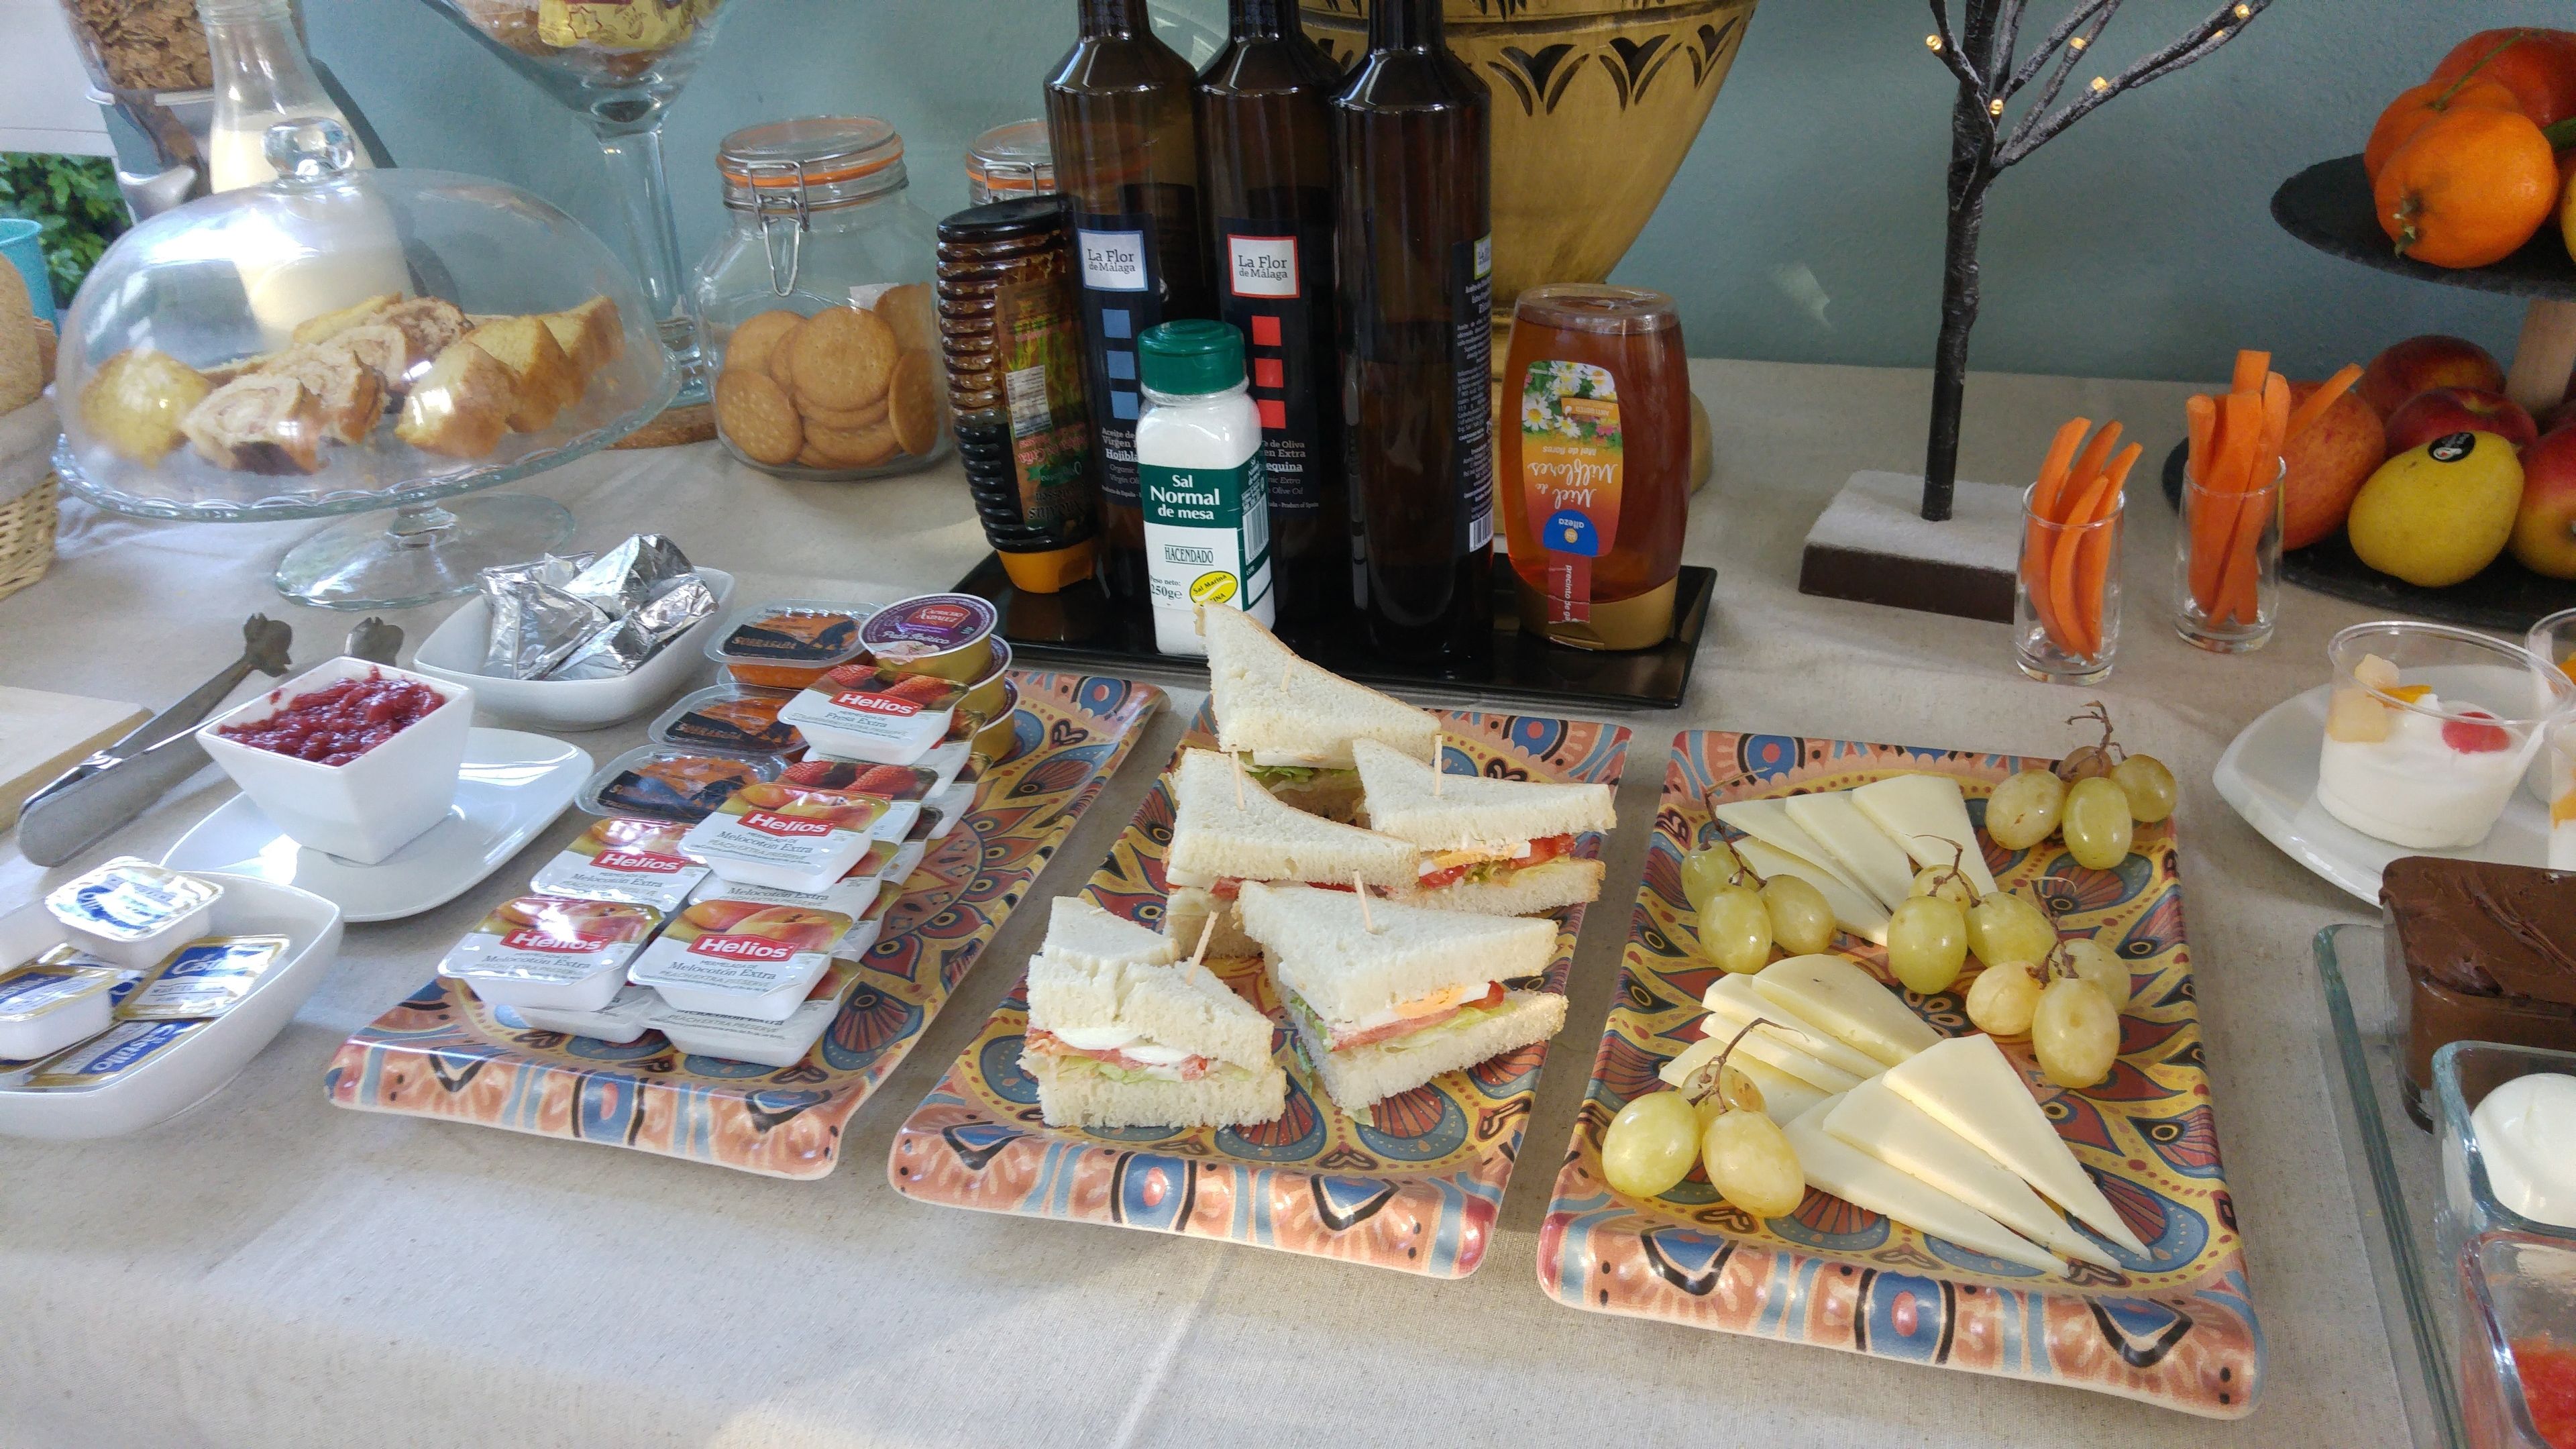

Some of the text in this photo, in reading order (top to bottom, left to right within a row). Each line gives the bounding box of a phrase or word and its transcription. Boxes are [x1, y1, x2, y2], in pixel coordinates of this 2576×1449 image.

[1087, 249, 1134, 262] La Flor
[1238, 255, 1287, 268] La Flor
[1089, 262, 1136, 274] de Málaga
[1239, 268, 1287, 280] de Málaga
[1102, 427, 1124, 437] Aceite
[1102, 435, 1131, 449] Virgen
[1270, 439, 1281, 447] de
[1281, 440, 1305, 449] Oliva
[1106, 448, 1138, 462] Hojibla
[1278, 449, 1306, 458] Extra
[1567, 447, 1578, 455] de
[1266, 462, 1303, 472] equina
[1172, 474, 1193, 488] Sal
[1150, 485, 1220, 505] Normal
[1158, 506, 1214, 520] de mesa
[1558, 518, 1585, 529] alteza
[1165, 547, 1214, 564] HACENDADO
[1193, 575, 1228, 594] Sal Marina
[1564, 565, 1572, 599] precinto
[838, 693, 914, 714] Helios
[824, 712, 855, 723] Fresa
[857, 717, 888, 727] Extra
[747, 813, 826, 833] Helios
[716, 830, 778, 849] Melocotón
[780, 843, 814, 853] Extra
[600, 853, 679, 871] Helios
[631, 879, 663, 888] Extra
[793, 892, 830, 901] Extra
[698, 938, 788, 959] Helios
[553, 959, 592, 969] Extra
[668, 961, 777, 980] Melocotón Extra
